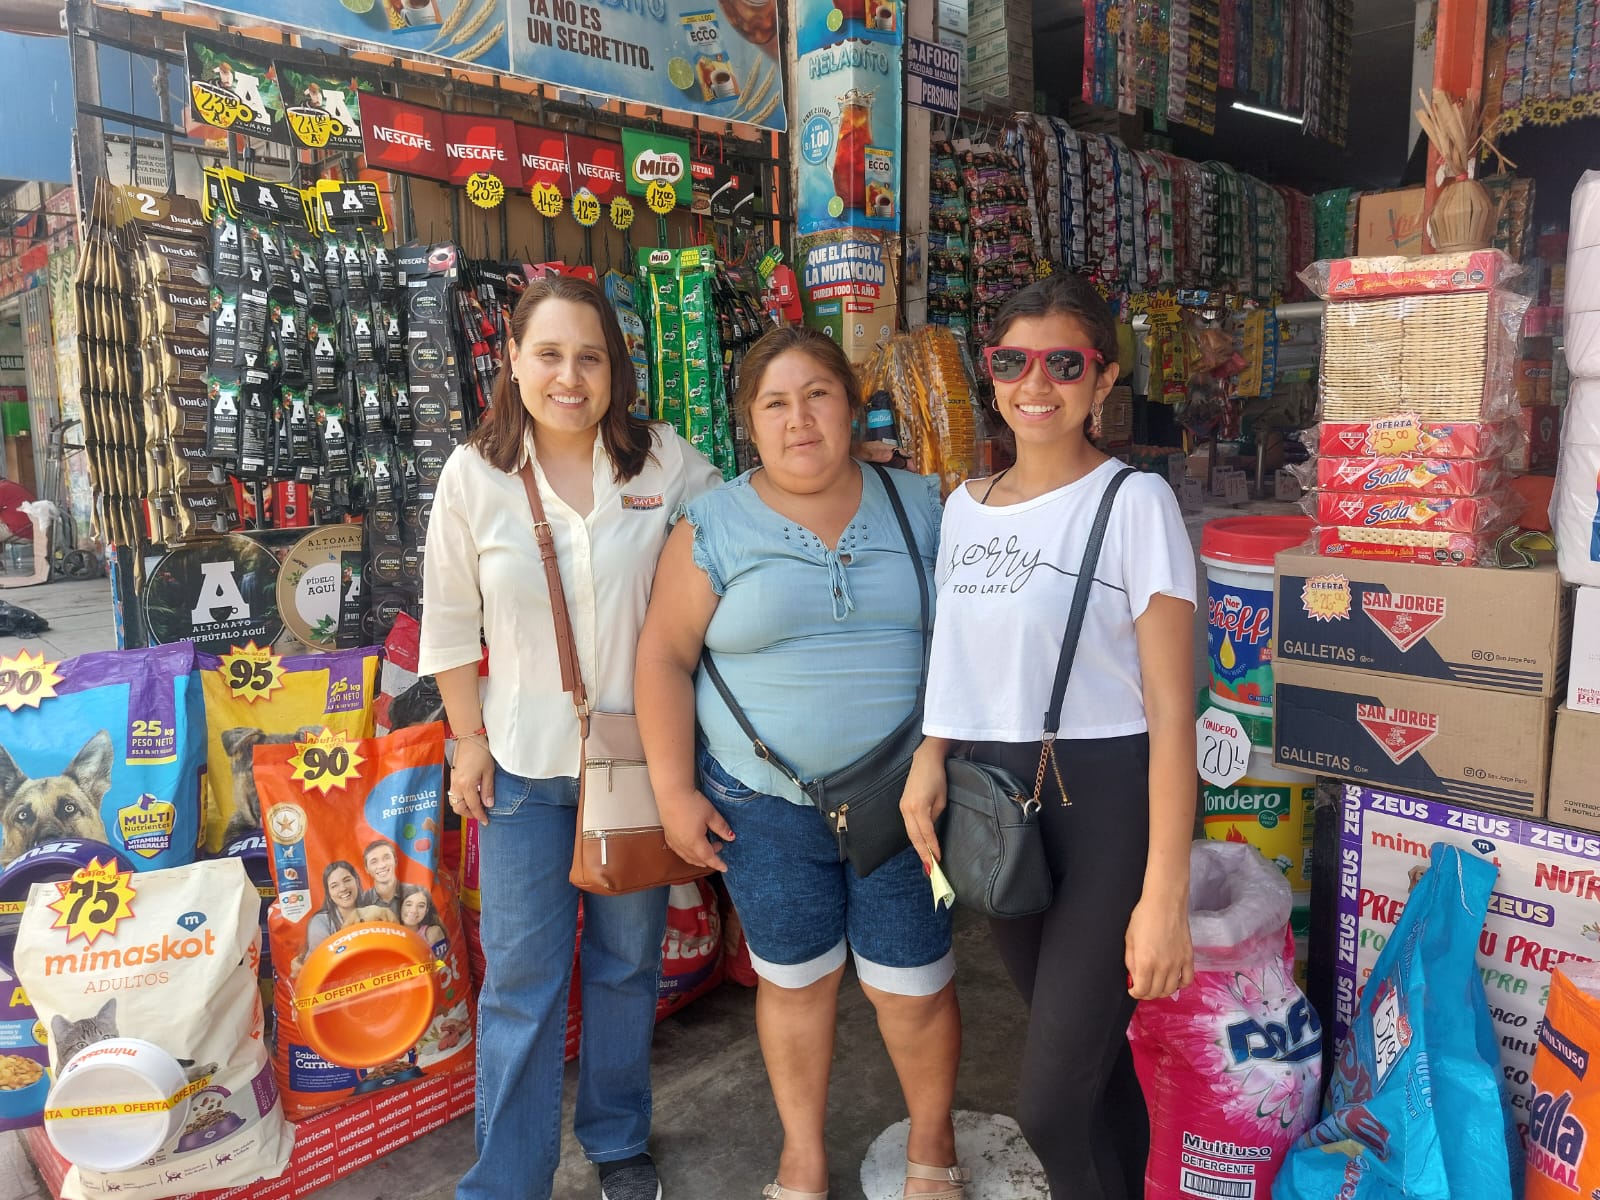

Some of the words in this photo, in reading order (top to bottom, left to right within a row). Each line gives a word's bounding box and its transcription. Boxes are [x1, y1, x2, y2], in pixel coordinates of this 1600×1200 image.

[553, 0, 577, 25] NO
[580, 5, 602, 31] ES
[527, 17, 553, 47] UN
[556, 25, 655, 72] SECRETITO.
[690, 29, 717, 43] ECCO
[808, 48, 889, 80] HELADITO
[918, 44, 958, 75] AFORO
[922, 83, 958, 111] PERSONAS
[810, 129, 829, 150] 1.00
[639, 160, 680, 177] MILO
[868, 161, 890, 172] ECCO
[136, 193, 160, 217] 2
[651, 253, 670, 262] MILO
[808, 248, 829, 266] QUE
[828, 246, 842, 261] EL
[841, 243, 874, 262] AMOR
[873, 247, 880, 262] Y
[805, 269, 819, 287] LA
[820, 262, 884, 286] NUTRICIÓN
[834, 285, 851, 297] TODO
[1376, 419, 1412, 430] OFERTA
[1363, 464, 1411, 491] Soda
[1363, 499, 1411, 526] Soda
[306, 575, 336, 586] PÍDELO
[307, 584, 336, 597] AQUÍ
[953, 584, 977, 594] TOO
[980, 584, 1008, 594] LATE
[1311, 582, 1344, 590] OFERTA
[191, 560, 251, 626] A
[1225, 595, 1241, 609] Nor
[1363, 591, 1393, 609] SAN
[1394, 594, 1444, 613] JORGE
[192, 619, 251, 633] ALTOMAYO
[241, 625, 266, 638] AQUÍ
[1208, 597, 1271, 645] Cheff
[1283, 639, 1356, 662] GALLETAS
[229, 659, 273, 691] 95
[343, 692, 360, 701] NETO
[350, 684, 361, 692] kg
[1357, 703, 1386, 720] SAN
[1388, 708, 1438, 729] JORGE
[131, 720, 163, 737] 25
[164, 727, 175, 738] kg
[1202, 717, 1238, 739] TONDERO
[132, 738, 153, 747] PESO
[155, 737, 174, 748] NETO
[303, 746, 350, 780] 90
[1280, 745, 1350, 771] GALLETAS
[390, 788, 437, 806] Fórmula
[1204, 789, 1281, 813] Tondero
[124, 811, 170, 825] MULTI
[382, 799, 438, 820] Renovada
[1344, 783, 1362, 837] ZEUS
[1371, 793, 1430, 820] ZEUS
[1446, 809, 1511, 838] ZEUS
[1530, 827, 1600, 858] ZEUS
[127, 834, 169, 845] VITAMINAS
[127, 841, 169, 850] MINERALES
[1477, 841, 1490, 851] m
[1341, 848, 1360, 901] ZEUS
[66, 879, 120, 925] 75
[1489, 897, 1549, 923] ZEUS
[184, 914, 200, 925] m
[1338, 913, 1356, 965] ZEUS
[45, 928, 216, 977] mimaskot
[84, 971, 169, 994] ADULTOS
[324, 982, 366, 1002] OFERTA
[372, 968, 413, 987] OFERTA
[1336, 975, 1354, 1028] ZEUS
[71, 1105, 118, 1117] OFERTA
[123, 1100, 170, 1113] OFERTA
[173, 1077, 210, 1105] OFERTA
[375, 1090, 409, 1111] nutrican
[415, 1087, 448, 1107] nutrican
[334, 1109, 370, 1130] nutrican
[378, 1103, 412, 1126] nutrican
[415, 1100, 448, 1120] nutrican
[294, 1127, 331, 1149] nutrican
[340, 1121, 375, 1144] nutrican
[376, 1118, 410, 1139] nutrican
[412, 1118, 445, 1138] nutrican
[297, 1141, 334, 1165] nutrican
[337, 1136, 373, 1158] nutrican
[375, 1135, 409, 1156] nutrican
[1182, 1131, 1272, 1160] Multiuso
[297, 1154, 334, 1178] nutrican
[337, 1153, 373, 1175] nutrican
[1182, 1152, 1255, 1176] DETERGENTE
[295, 1173, 332, 1196] nutrican
